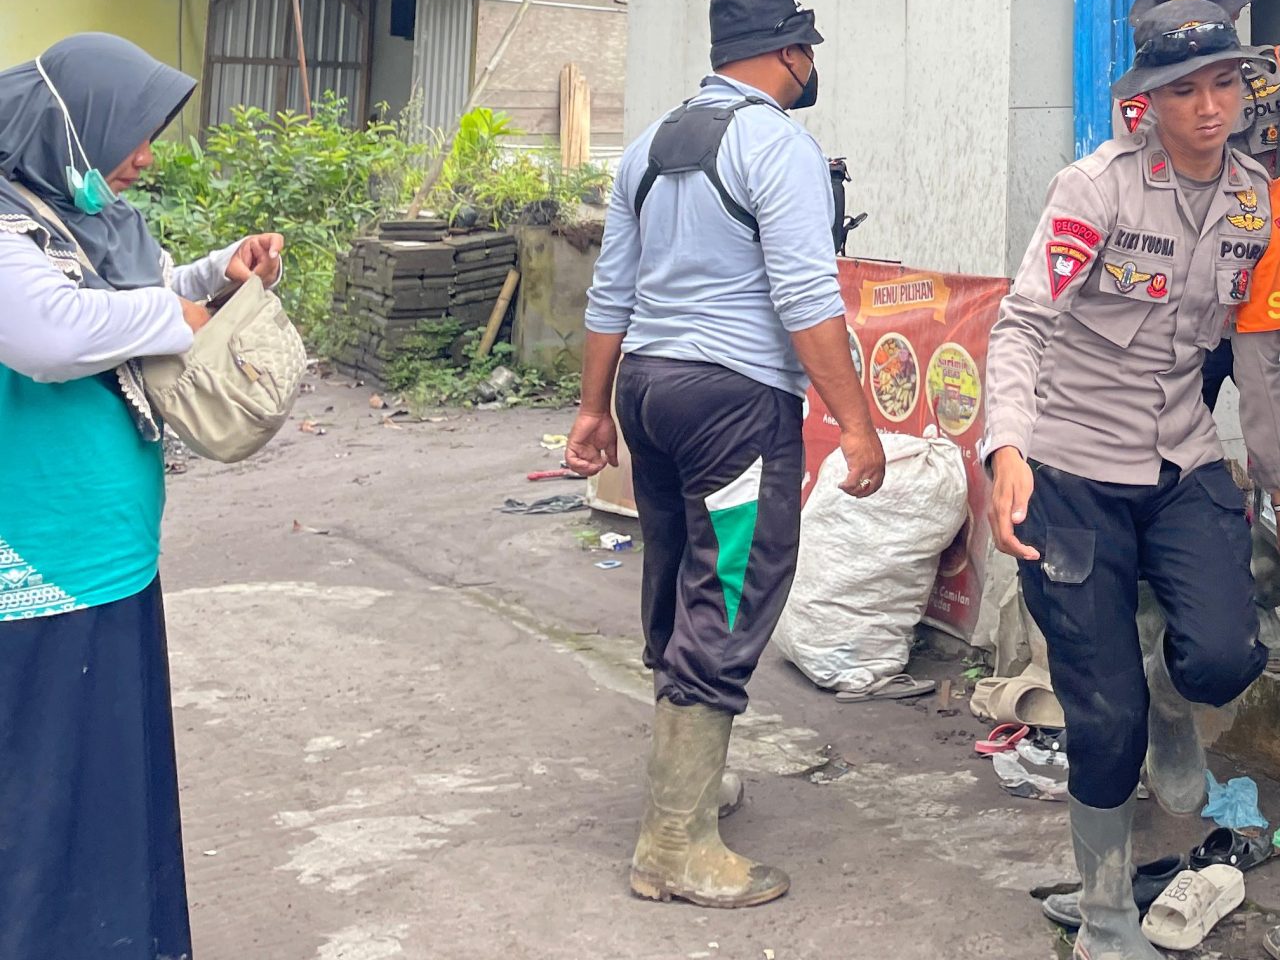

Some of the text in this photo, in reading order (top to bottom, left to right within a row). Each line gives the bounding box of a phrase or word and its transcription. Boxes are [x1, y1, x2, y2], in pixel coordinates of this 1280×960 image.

[1244, 100, 1280, 120] POL
[1055, 220, 1099, 246] PELOPOR
[1114, 229, 1175, 257] KIKI YUDHA
[873, 280, 934, 306] MENU PILIHAN
[823, 413, 840, 427] Ane
[940, 586, 970, 606] Camilan
